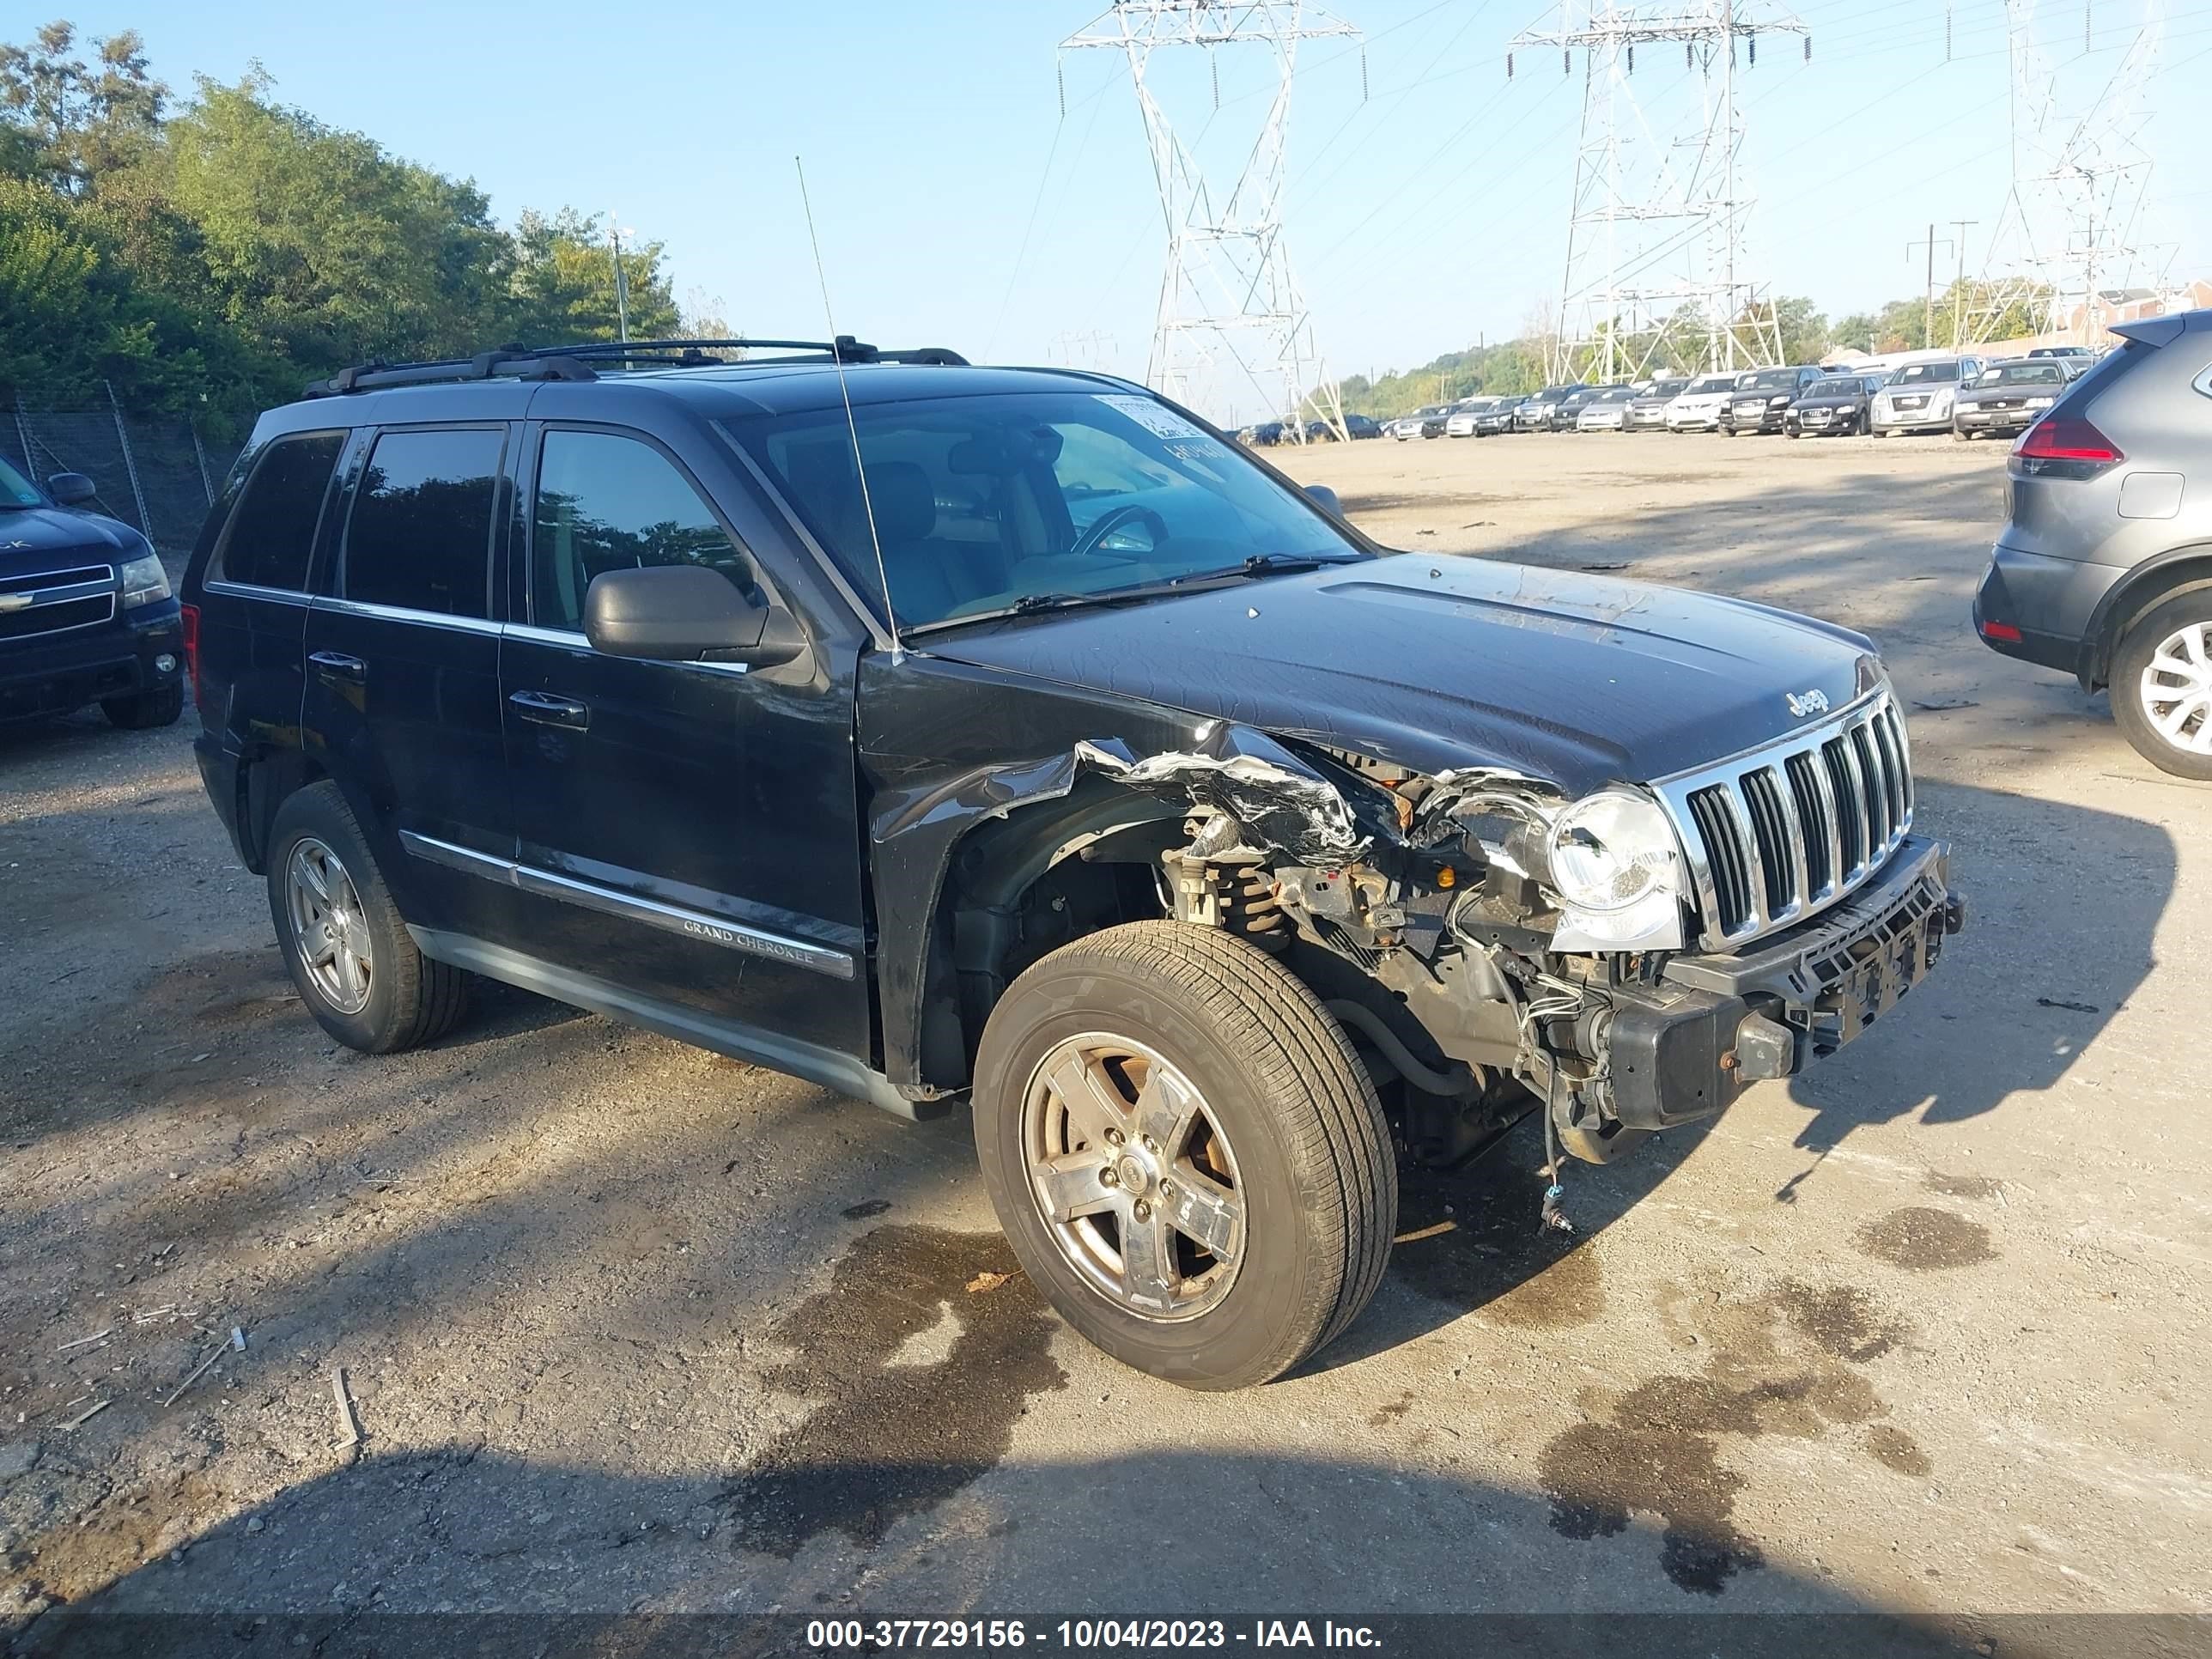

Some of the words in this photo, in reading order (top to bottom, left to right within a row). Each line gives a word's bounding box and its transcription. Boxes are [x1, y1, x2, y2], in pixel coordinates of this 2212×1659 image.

[1786, 689, 1829, 717] Jeep
[684, 920, 733, 941] GRAND
[737, 934, 815, 964] CHEROKEE
